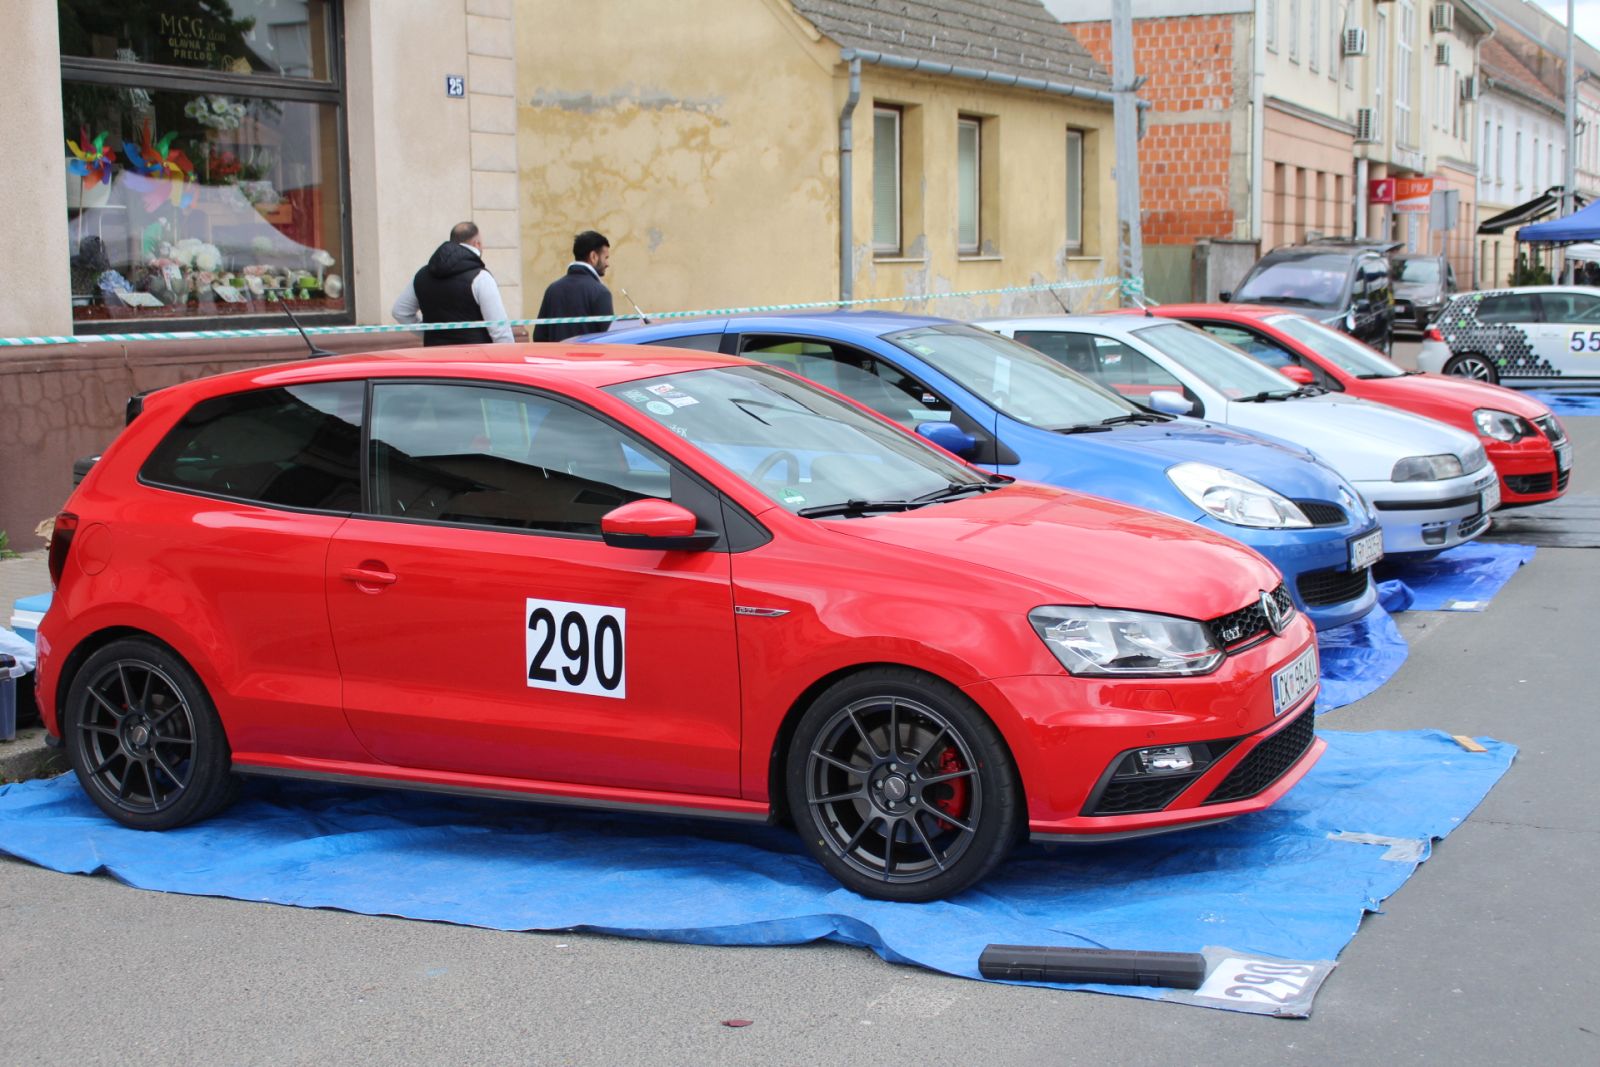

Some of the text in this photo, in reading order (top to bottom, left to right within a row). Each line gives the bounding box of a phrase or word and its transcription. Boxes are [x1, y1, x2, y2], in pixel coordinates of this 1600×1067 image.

[449, 78, 463, 95] 25
[528, 607, 623, 690] 290
[1224, 963, 1312, 1003] 290
